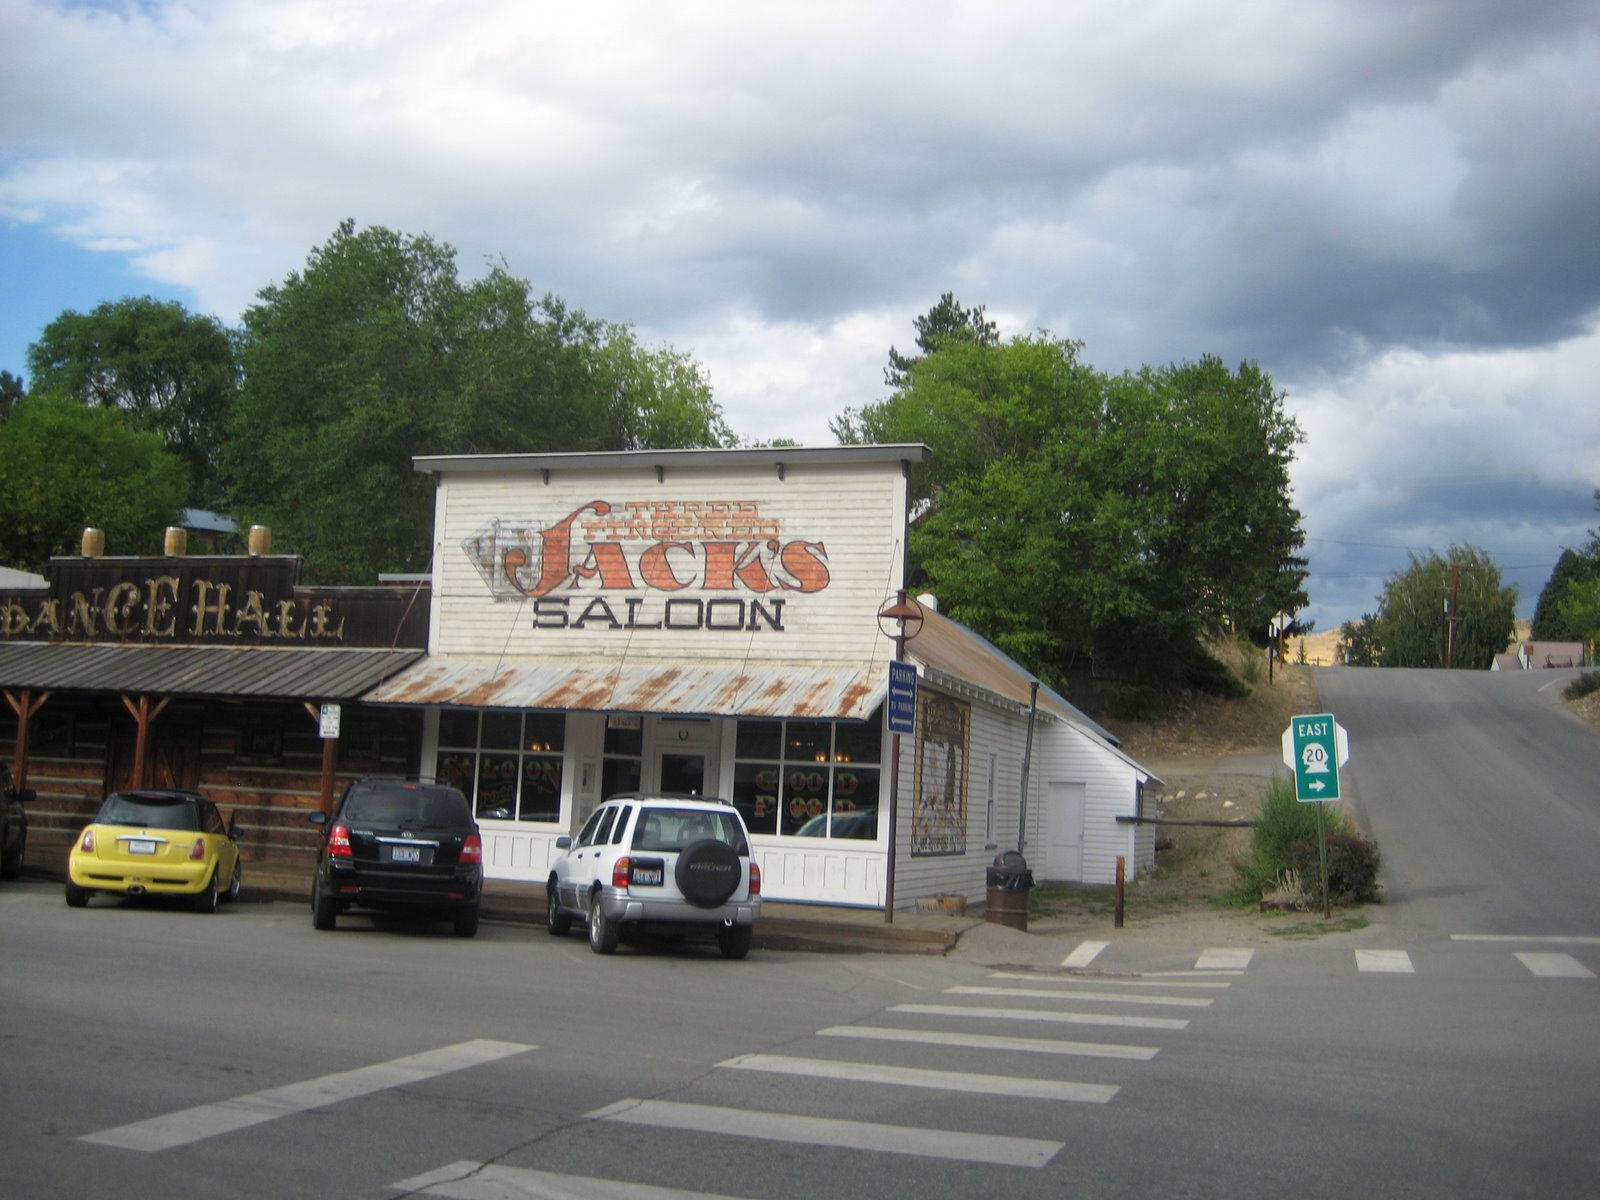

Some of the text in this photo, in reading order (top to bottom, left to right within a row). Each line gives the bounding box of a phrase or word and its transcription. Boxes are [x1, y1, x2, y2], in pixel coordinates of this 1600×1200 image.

[623, 500, 760, 519] THREE
[580, 520, 781, 540] FINGERED
[503, 500, 830, 597] JACK'S
[0, 576, 344, 640] DANCE HALL
[533, 597, 786, 632] SALOON
[891, 666, 915, 686] PARKING
[1298, 722, 1328, 737] EAST
[1306, 748, 1324, 762] 20
[756, 770, 859, 794] GOOD
[754, 795, 857, 818] FOOD
